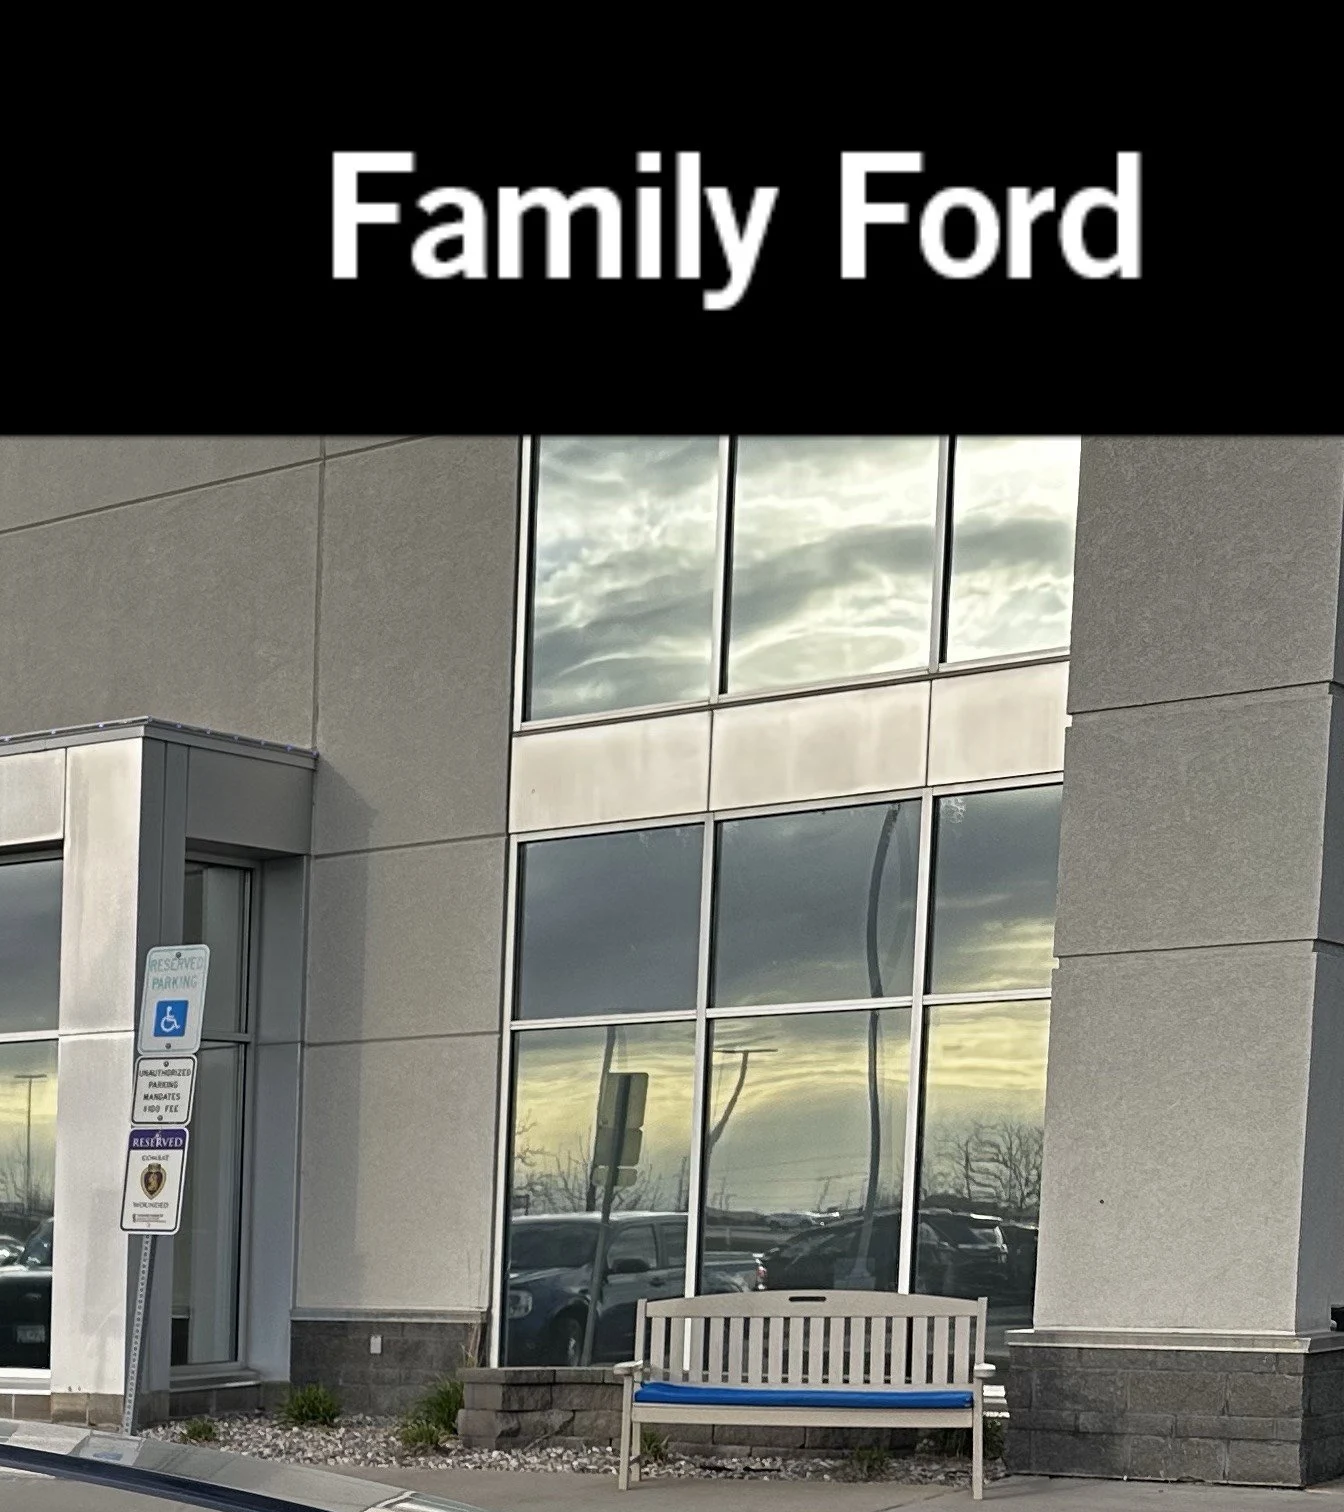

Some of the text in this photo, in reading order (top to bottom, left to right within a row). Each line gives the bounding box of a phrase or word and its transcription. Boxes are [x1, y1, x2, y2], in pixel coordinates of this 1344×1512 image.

[149, 957, 204, 972] RESERVED
[152, 975, 198, 990] PARKING
[138, 1069, 192, 1077] UNAUTHORIZED
[164, 1104, 180, 1113] FEE
[132, 1137, 184, 1148] RESERVED
